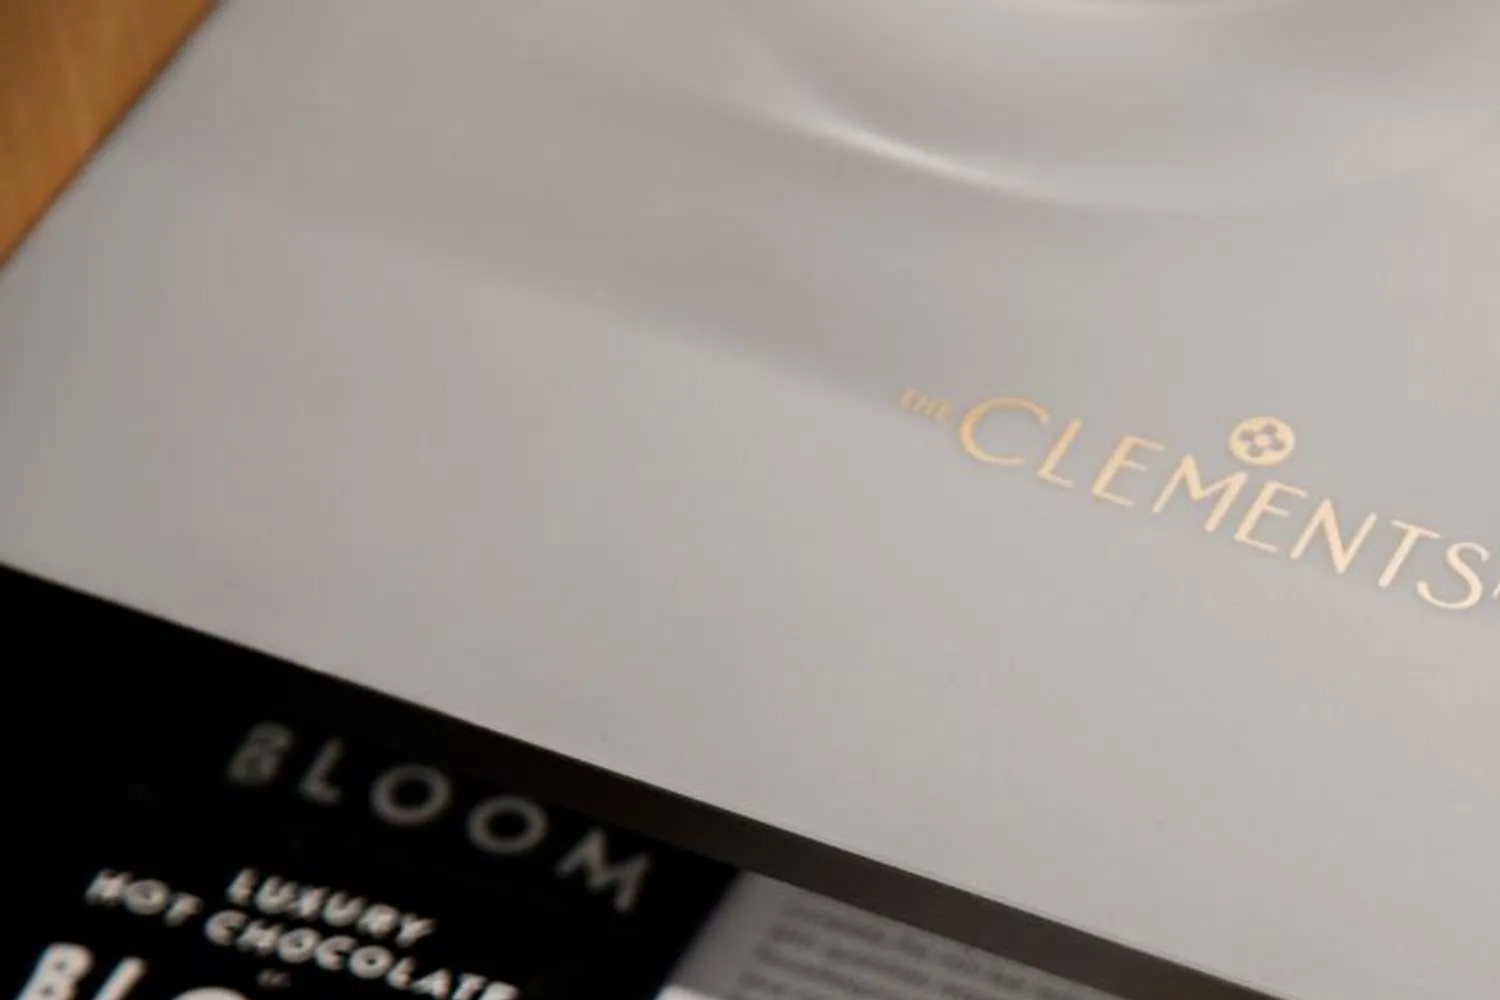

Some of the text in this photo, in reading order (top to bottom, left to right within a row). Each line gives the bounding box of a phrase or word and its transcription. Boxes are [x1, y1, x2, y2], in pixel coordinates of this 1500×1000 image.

[959, 396, 1492, 610] CLEMENTS
[226, 721, 651, 913] BLOOM
[85, 868, 201, 927] HOT
[227, 868, 436, 948] LUXURY
